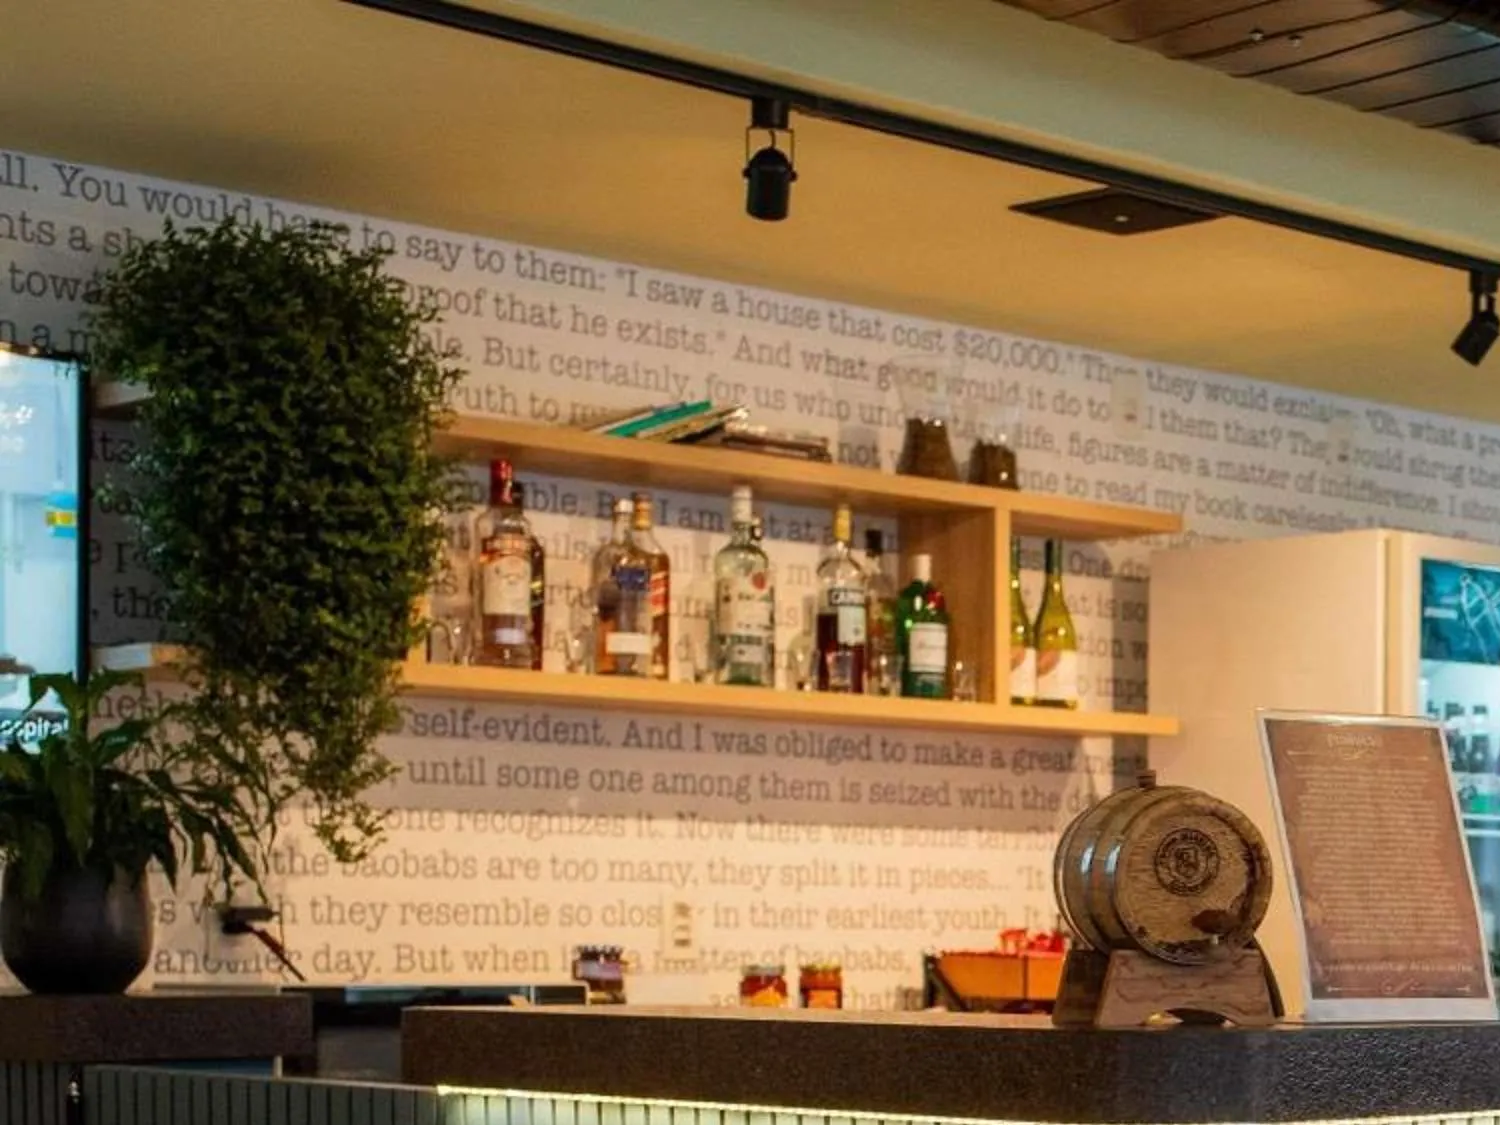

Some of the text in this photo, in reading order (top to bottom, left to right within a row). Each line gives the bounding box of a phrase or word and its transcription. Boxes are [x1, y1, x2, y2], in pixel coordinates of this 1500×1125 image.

[0, 153, 39, 192] ll.
[53, 163, 128, 208] You
[138, 186, 254, 228] would
[266, 202, 351, 251] hae
[361, 221, 396, 256] to
[405, 233, 462, 272] say
[474, 240, 505, 274] to
[514, 250, 607, 292] them:
[646, 278, 703, 310] saw
[711, 291, 729, 315] a
[737, 290, 821, 331] house
[827, 308, 886, 343] that
[892, 323, 946, 353] cost
[1146, 367, 1199, 403] they
[1203, 382, 1268, 412] would
[69, 225, 92, 253] a
[494, 290, 562, 331] that
[571, 304, 608, 338] he
[733, 335, 791, 369] And
[800, 348, 869, 383] what
[877, 362, 937, 393] good
[1027, 384, 1048, 412] it
[1052, 388, 1082, 417] do
[1088, 396, 1111, 421] to
[483, 336, 541, 373] But
[550, 352, 697, 401] certainly,
[704, 371, 747, 403] for
[754, 384, 785, 411] us
[793, 388, 850, 421] who
[1068, 432, 1148, 468] figures
[1153, 449, 1193, 474] are
[1197, 456, 1211, 477] a
[447, 383, 519, 417] ruth
[529, 391, 559, 421] to
[837, 441, 881, 468] not
[1065, 473, 1089, 498] to
[1095, 479, 1147, 508] read
[1194, 489, 1248, 521] book
[678, 504, 725, 532] am
[1069, 551, 1113, 579] One
[411, 707, 612, 748] self-evident.
[621, 719, 683, 752] And
[692, 721, 704, 753] I
[711, 731, 768, 756] was
[774, 729, 873, 766] obliged
[879, 735, 906, 763] to
[913, 741, 984, 769] make
[990, 748, 1007, 770] a
[406, 755, 489, 786] until
[496, 764, 580, 791] some
[588, 768, 644, 793] one
[652, 771, 752, 806] among
[759, 772, 831, 802] them
[839, 777, 862, 804] is
[868, 781, 951, 808] seized
[957, 785, 1015, 812] with
[1020, 785, 1060, 813] the
[455, 806, 625, 841] recognizes
[675, 809, 736, 842] Now
[270, 845, 329, 876] the
[341, 847, 479, 881] baobabs
[486, 853, 542, 881] are
[549, 852, 600, 882] too
[607, 857, 699, 890] many,
[706, 856, 771, 892] they
[779, 856, 841, 893] split
[848, 860, 869, 888] it
[876, 859, 901, 888] in
[310, 893, 388, 934] they
[398, 896, 551, 928] resemble
[557, 904, 593, 929] so
[713, 901, 741, 930] in
[749, 901, 819, 929] their
[826, 903, 926, 931] earliest
[312, 942, 382, 981] day.
[392, 943, 454, 974] But
[463, 943, 551, 974] when
